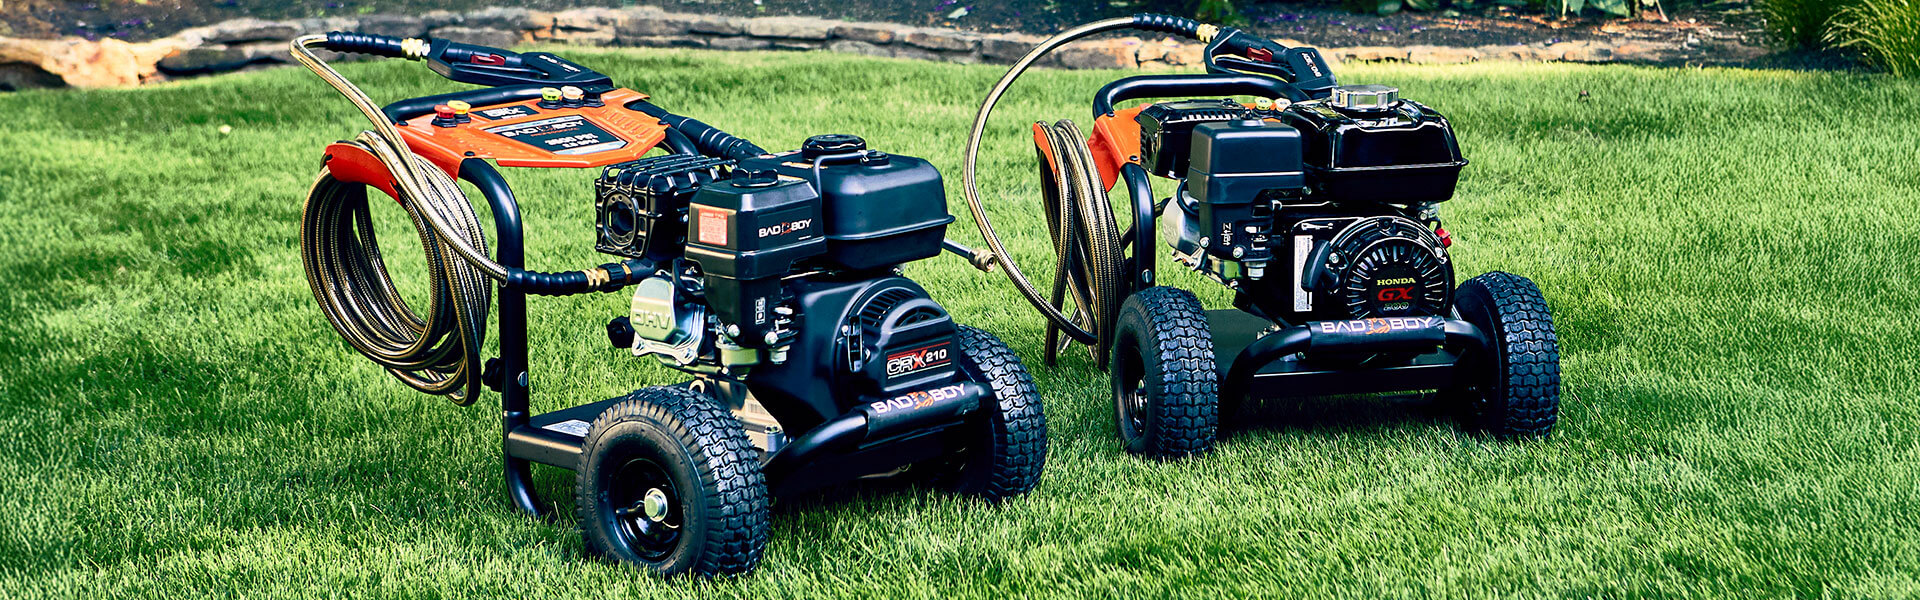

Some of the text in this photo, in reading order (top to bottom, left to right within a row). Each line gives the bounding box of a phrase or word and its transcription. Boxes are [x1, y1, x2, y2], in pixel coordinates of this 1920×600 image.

[758, 218, 812, 238] BAD BOY
[1376, 277, 1416, 286] HONDA
[1377, 286, 1414, 301] GX
[632, 311, 671, 330] OHV
[1320, 317, 1432, 333] BAD BOY
[886, 348, 946, 376] CRX 210
[871, 383, 965, 414] BAD BOY
